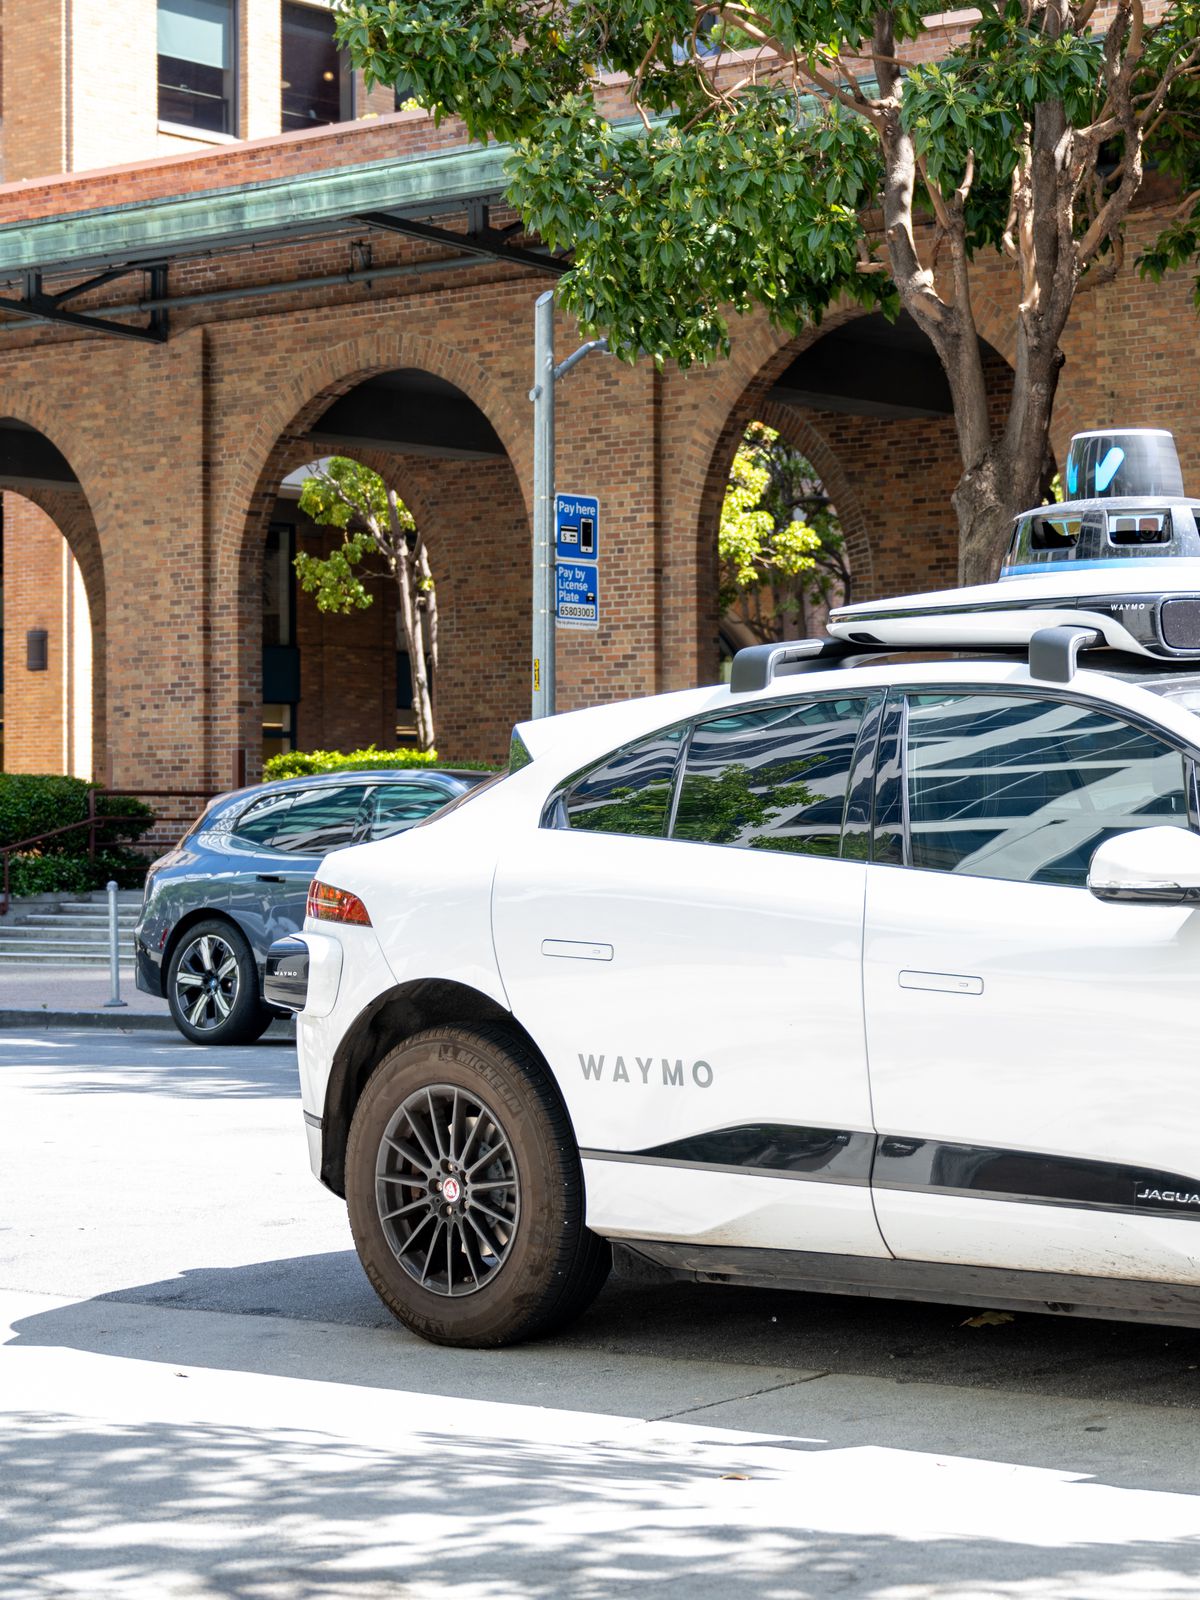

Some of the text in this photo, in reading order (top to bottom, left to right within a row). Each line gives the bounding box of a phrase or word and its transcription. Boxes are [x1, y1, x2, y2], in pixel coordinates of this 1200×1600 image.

[559, 501, 596, 517] Pay here
[559, 566, 586, 582] Pay by
[559, 578, 589, 592] License
[559, 590, 580, 602] Plate
[560, 606, 595, 618] 65803003
[1110, 603, 1145, 611] WAYMO
[578, 1053, 713, 1089] WAYMO
[457, 1050, 523, 1113] MICHELIN
